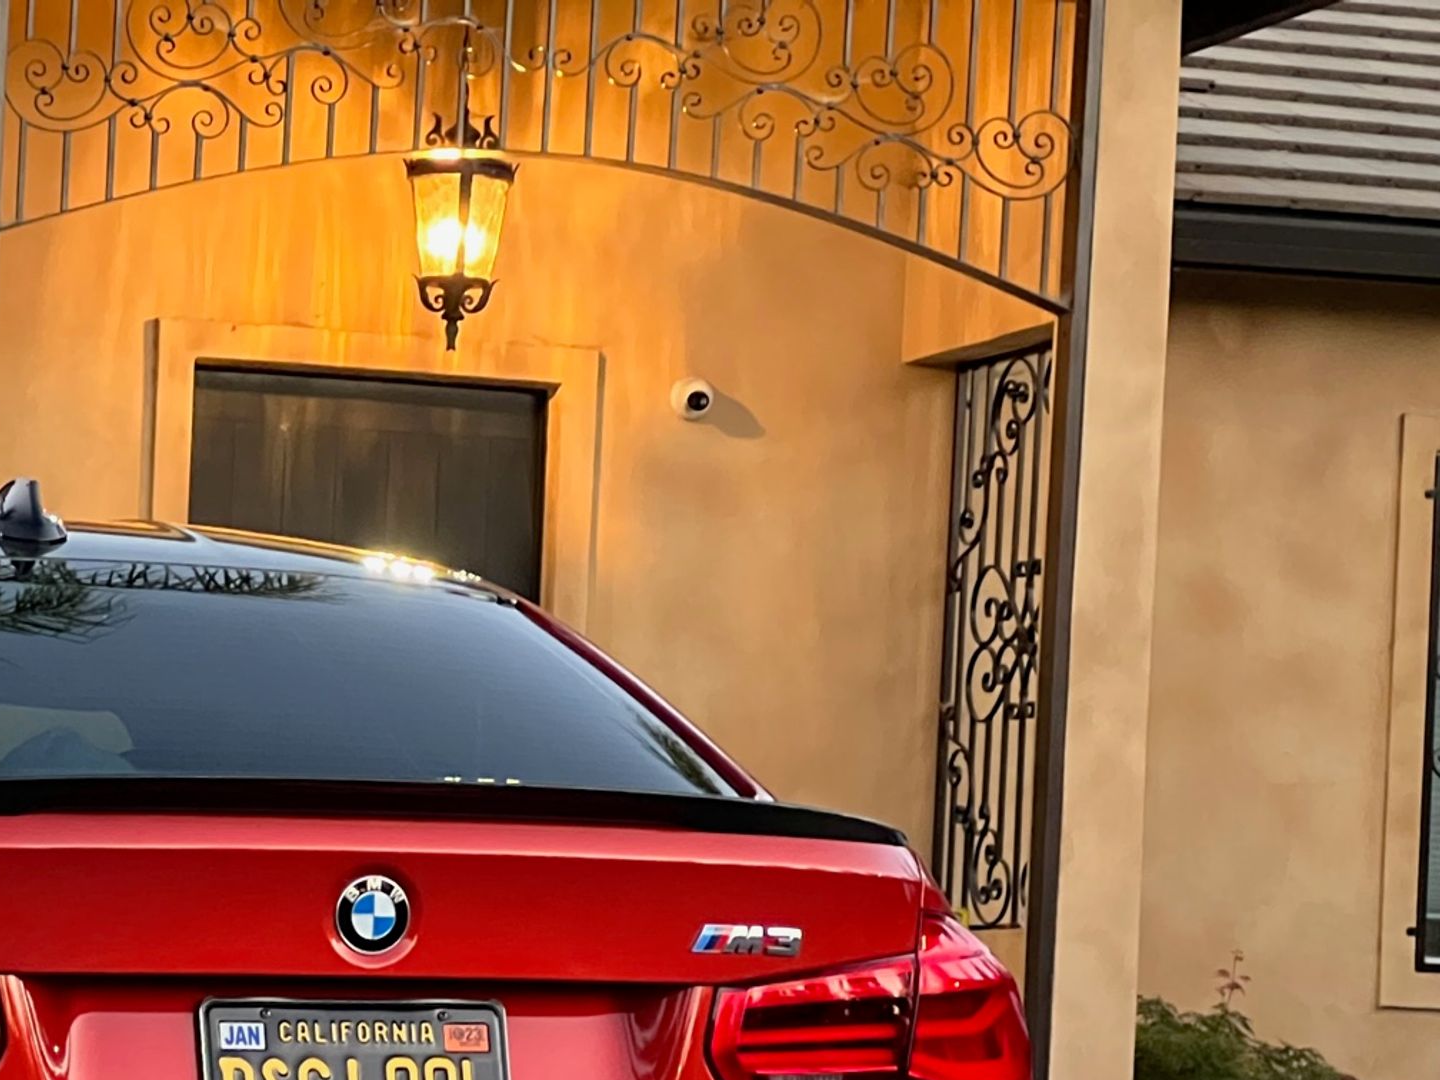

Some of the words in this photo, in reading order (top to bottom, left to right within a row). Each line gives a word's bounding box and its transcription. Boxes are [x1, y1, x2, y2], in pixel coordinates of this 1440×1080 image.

[344, 878, 406, 903] BMW
[224, 1025, 261, 1046] JAN
[278, 1021, 436, 1045] CALIFORNIA
